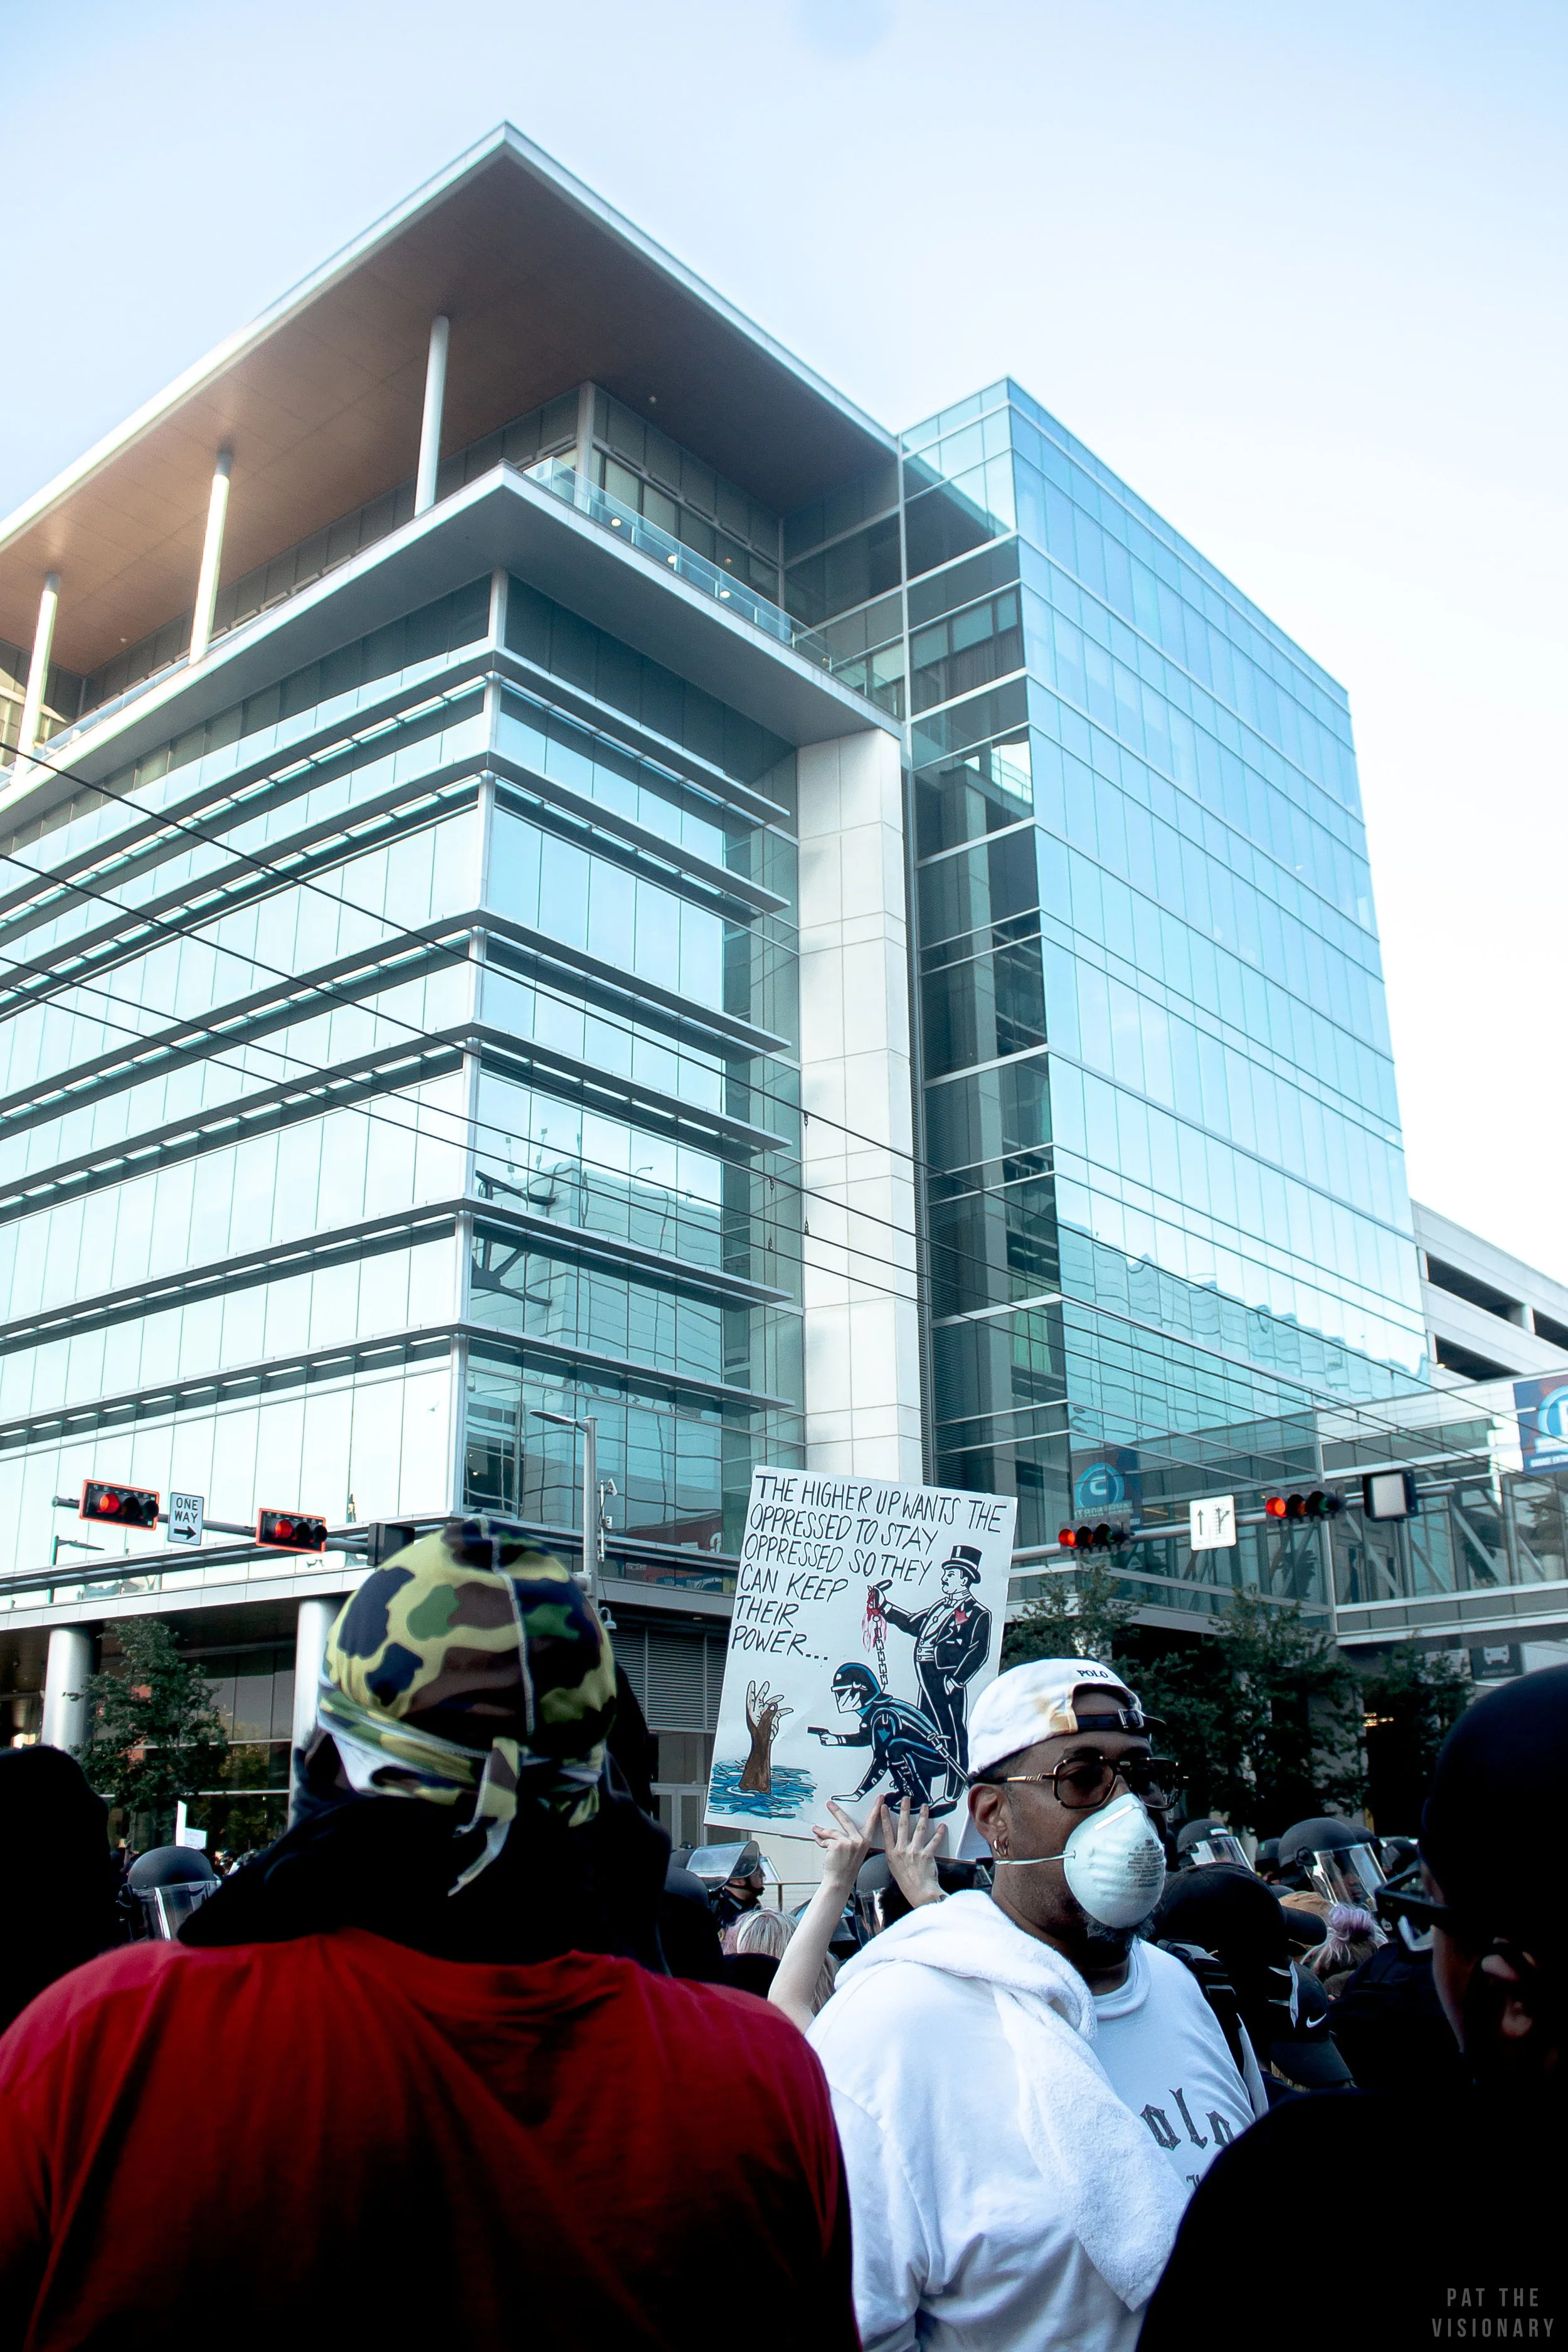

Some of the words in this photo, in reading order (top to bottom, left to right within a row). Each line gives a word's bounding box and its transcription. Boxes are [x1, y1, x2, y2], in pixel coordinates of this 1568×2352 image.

[174, 1510, 199, 1523] WAY
[176, 1497, 198, 1511] ONE
[755, 1475, 798, 1502] THE
[801, 1480, 872, 1513] HIGHER
[876, 1490, 901, 1515] UP
[903, 1491, 961, 1525] WANTS
[968, 1500, 1007, 1533] THE
[750, 1503, 852, 1540] OPPRESSED
[856, 1518, 878, 1544] TO
[881, 1522, 938, 1555] STAY
[744, 1534, 844, 1573] OPPRESSED
[849, 1549, 876, 1577] SO
[881, 1554, 933, 1586] THEY
[740, 1563, 778, 1594] CAN
[786, 1572, 849, 1602] KEEP
[737, 1595, 799, 1628] THEIR
[731, 1625, 829, 1660] POWER...
[1076, 1670, 1109, 1678] POLO
[1139, 2087, 1234, 2151] olo
